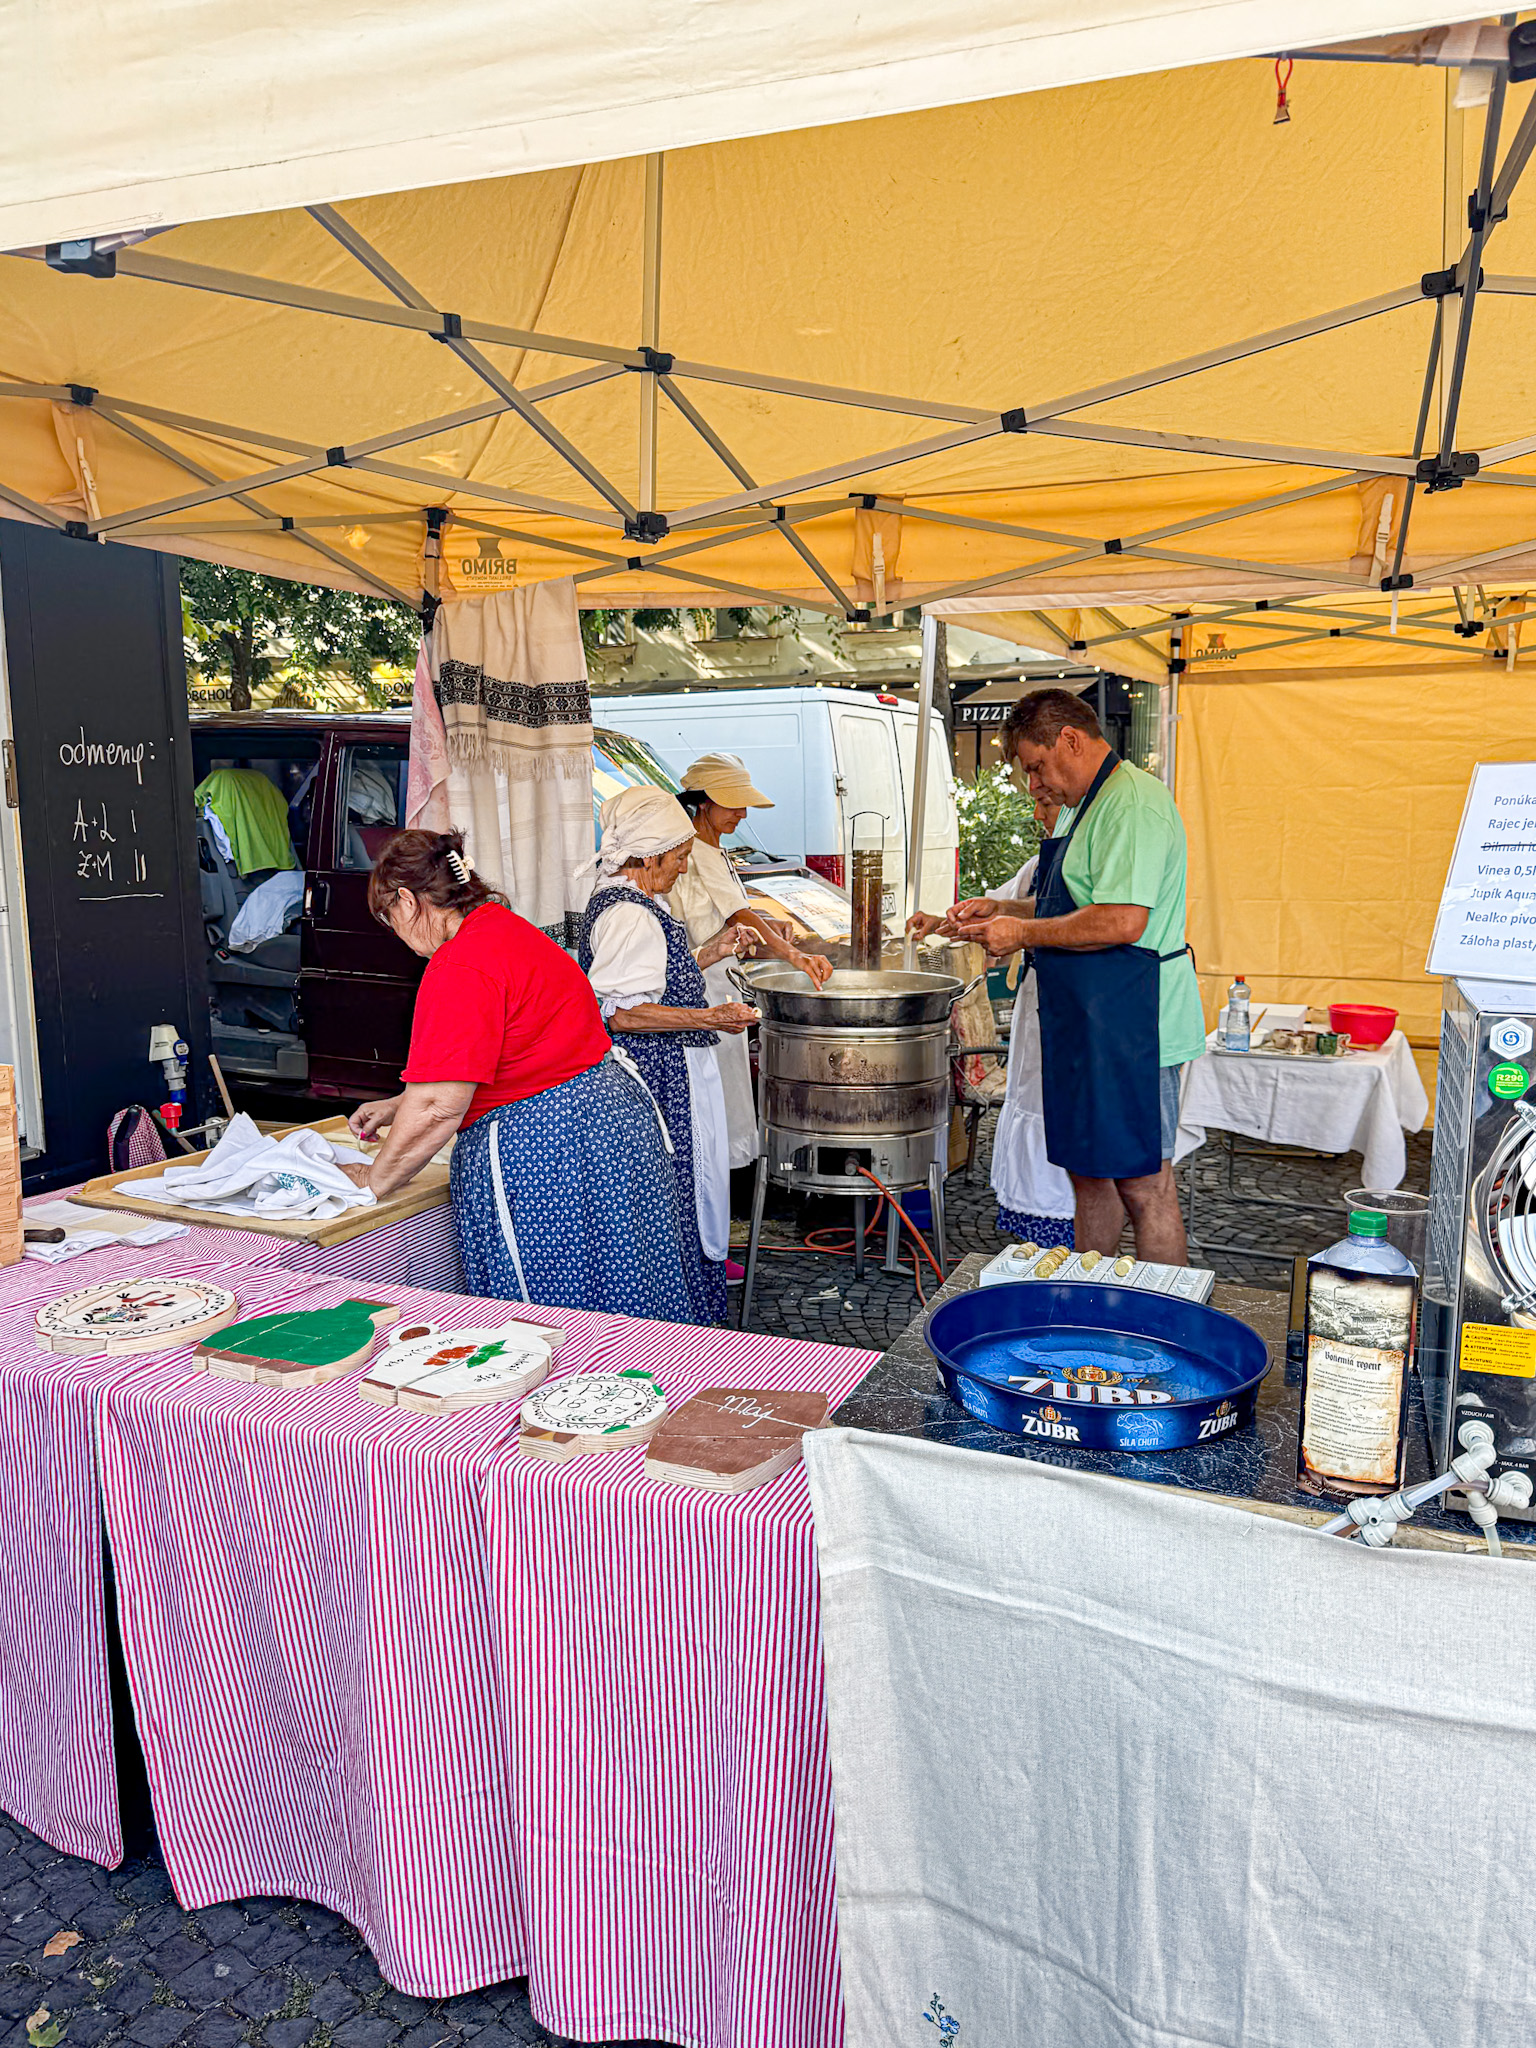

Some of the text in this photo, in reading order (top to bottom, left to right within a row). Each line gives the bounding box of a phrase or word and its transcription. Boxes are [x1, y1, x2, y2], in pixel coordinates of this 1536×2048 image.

[1488, 818, 1521, 831] Rajec
[1478, 864, 1511, 876] Vinea
[1466, 911, 1508, 923] Nealko
[1460, 934, 1500, 947] Záloha
[1496, 1073, 1524, 1082] R290
[1021, 1414, 1081, 1442] ZUBR
[1197, 1411, 1237, 1440] ZUBR
